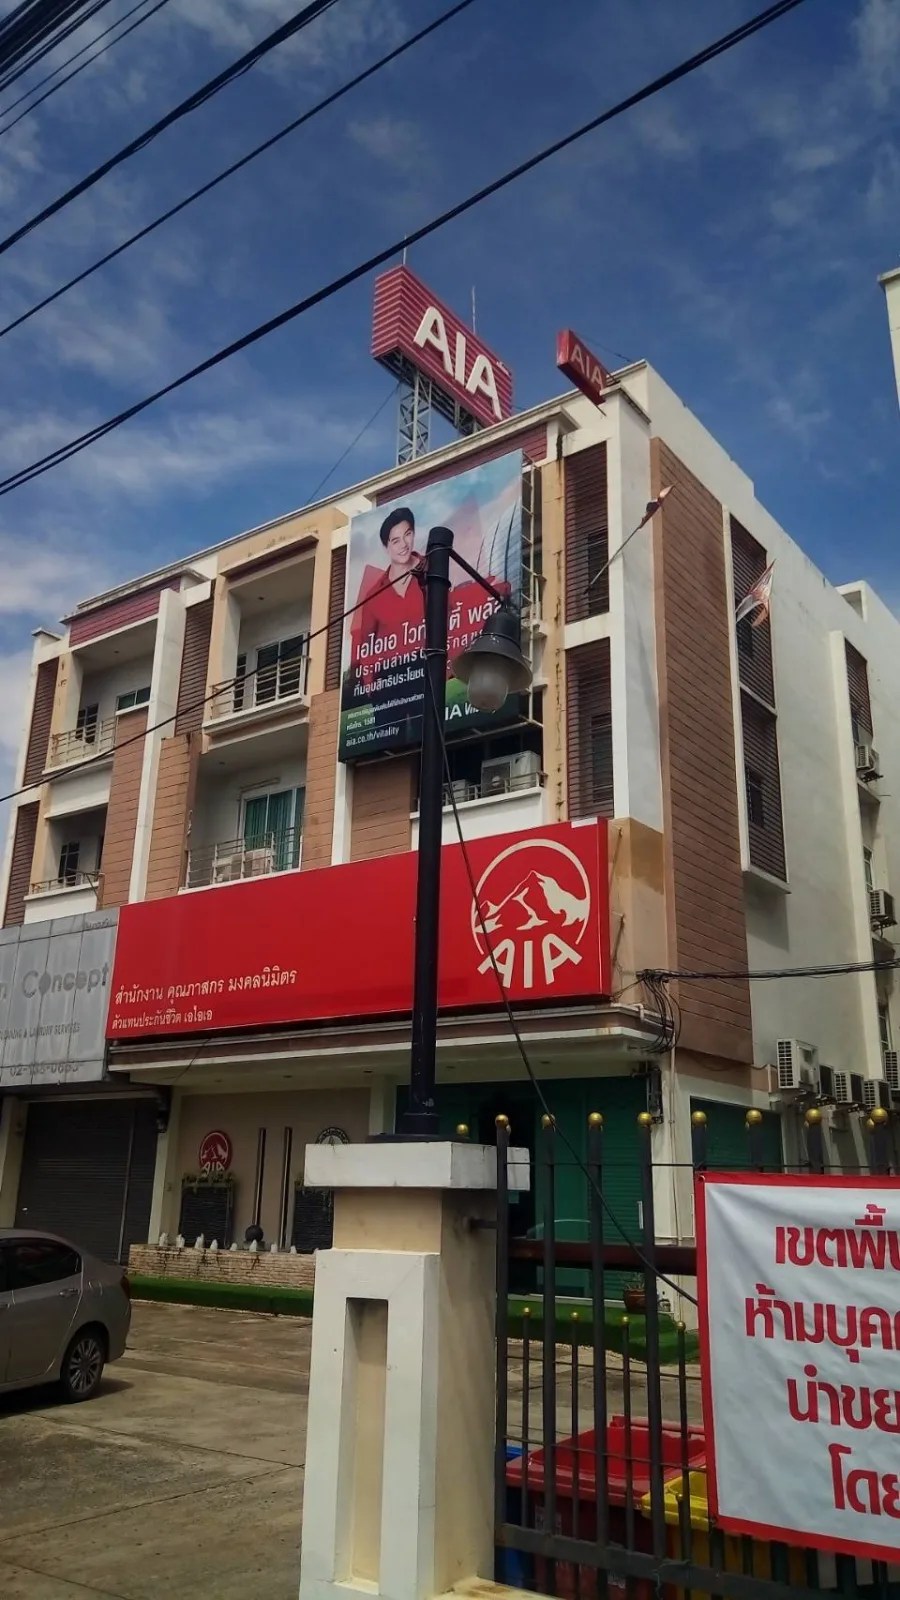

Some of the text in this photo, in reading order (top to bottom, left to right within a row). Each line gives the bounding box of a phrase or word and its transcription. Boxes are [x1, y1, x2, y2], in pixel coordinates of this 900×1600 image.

[413, 306, 502, 421] AIA
[571, 344, 604, 390] AIA
[357, 633, 397, 660] เอไอเอ
[445, 704, 462, 720] IA
[477, 933, 583, 989] AIA
[23, 963, 109, 998] Concept
[115, 965, 298, 1005] สำนักงาน คุณภาสกร มงคลนิมิตร
[112, 1005, 213, 1030] ตัวแทนประกันชีวิต เอไอเอ
[201, 1161, 225, 1178] AIA
[745, 1283, 900, 1363] ห้ามบุค
